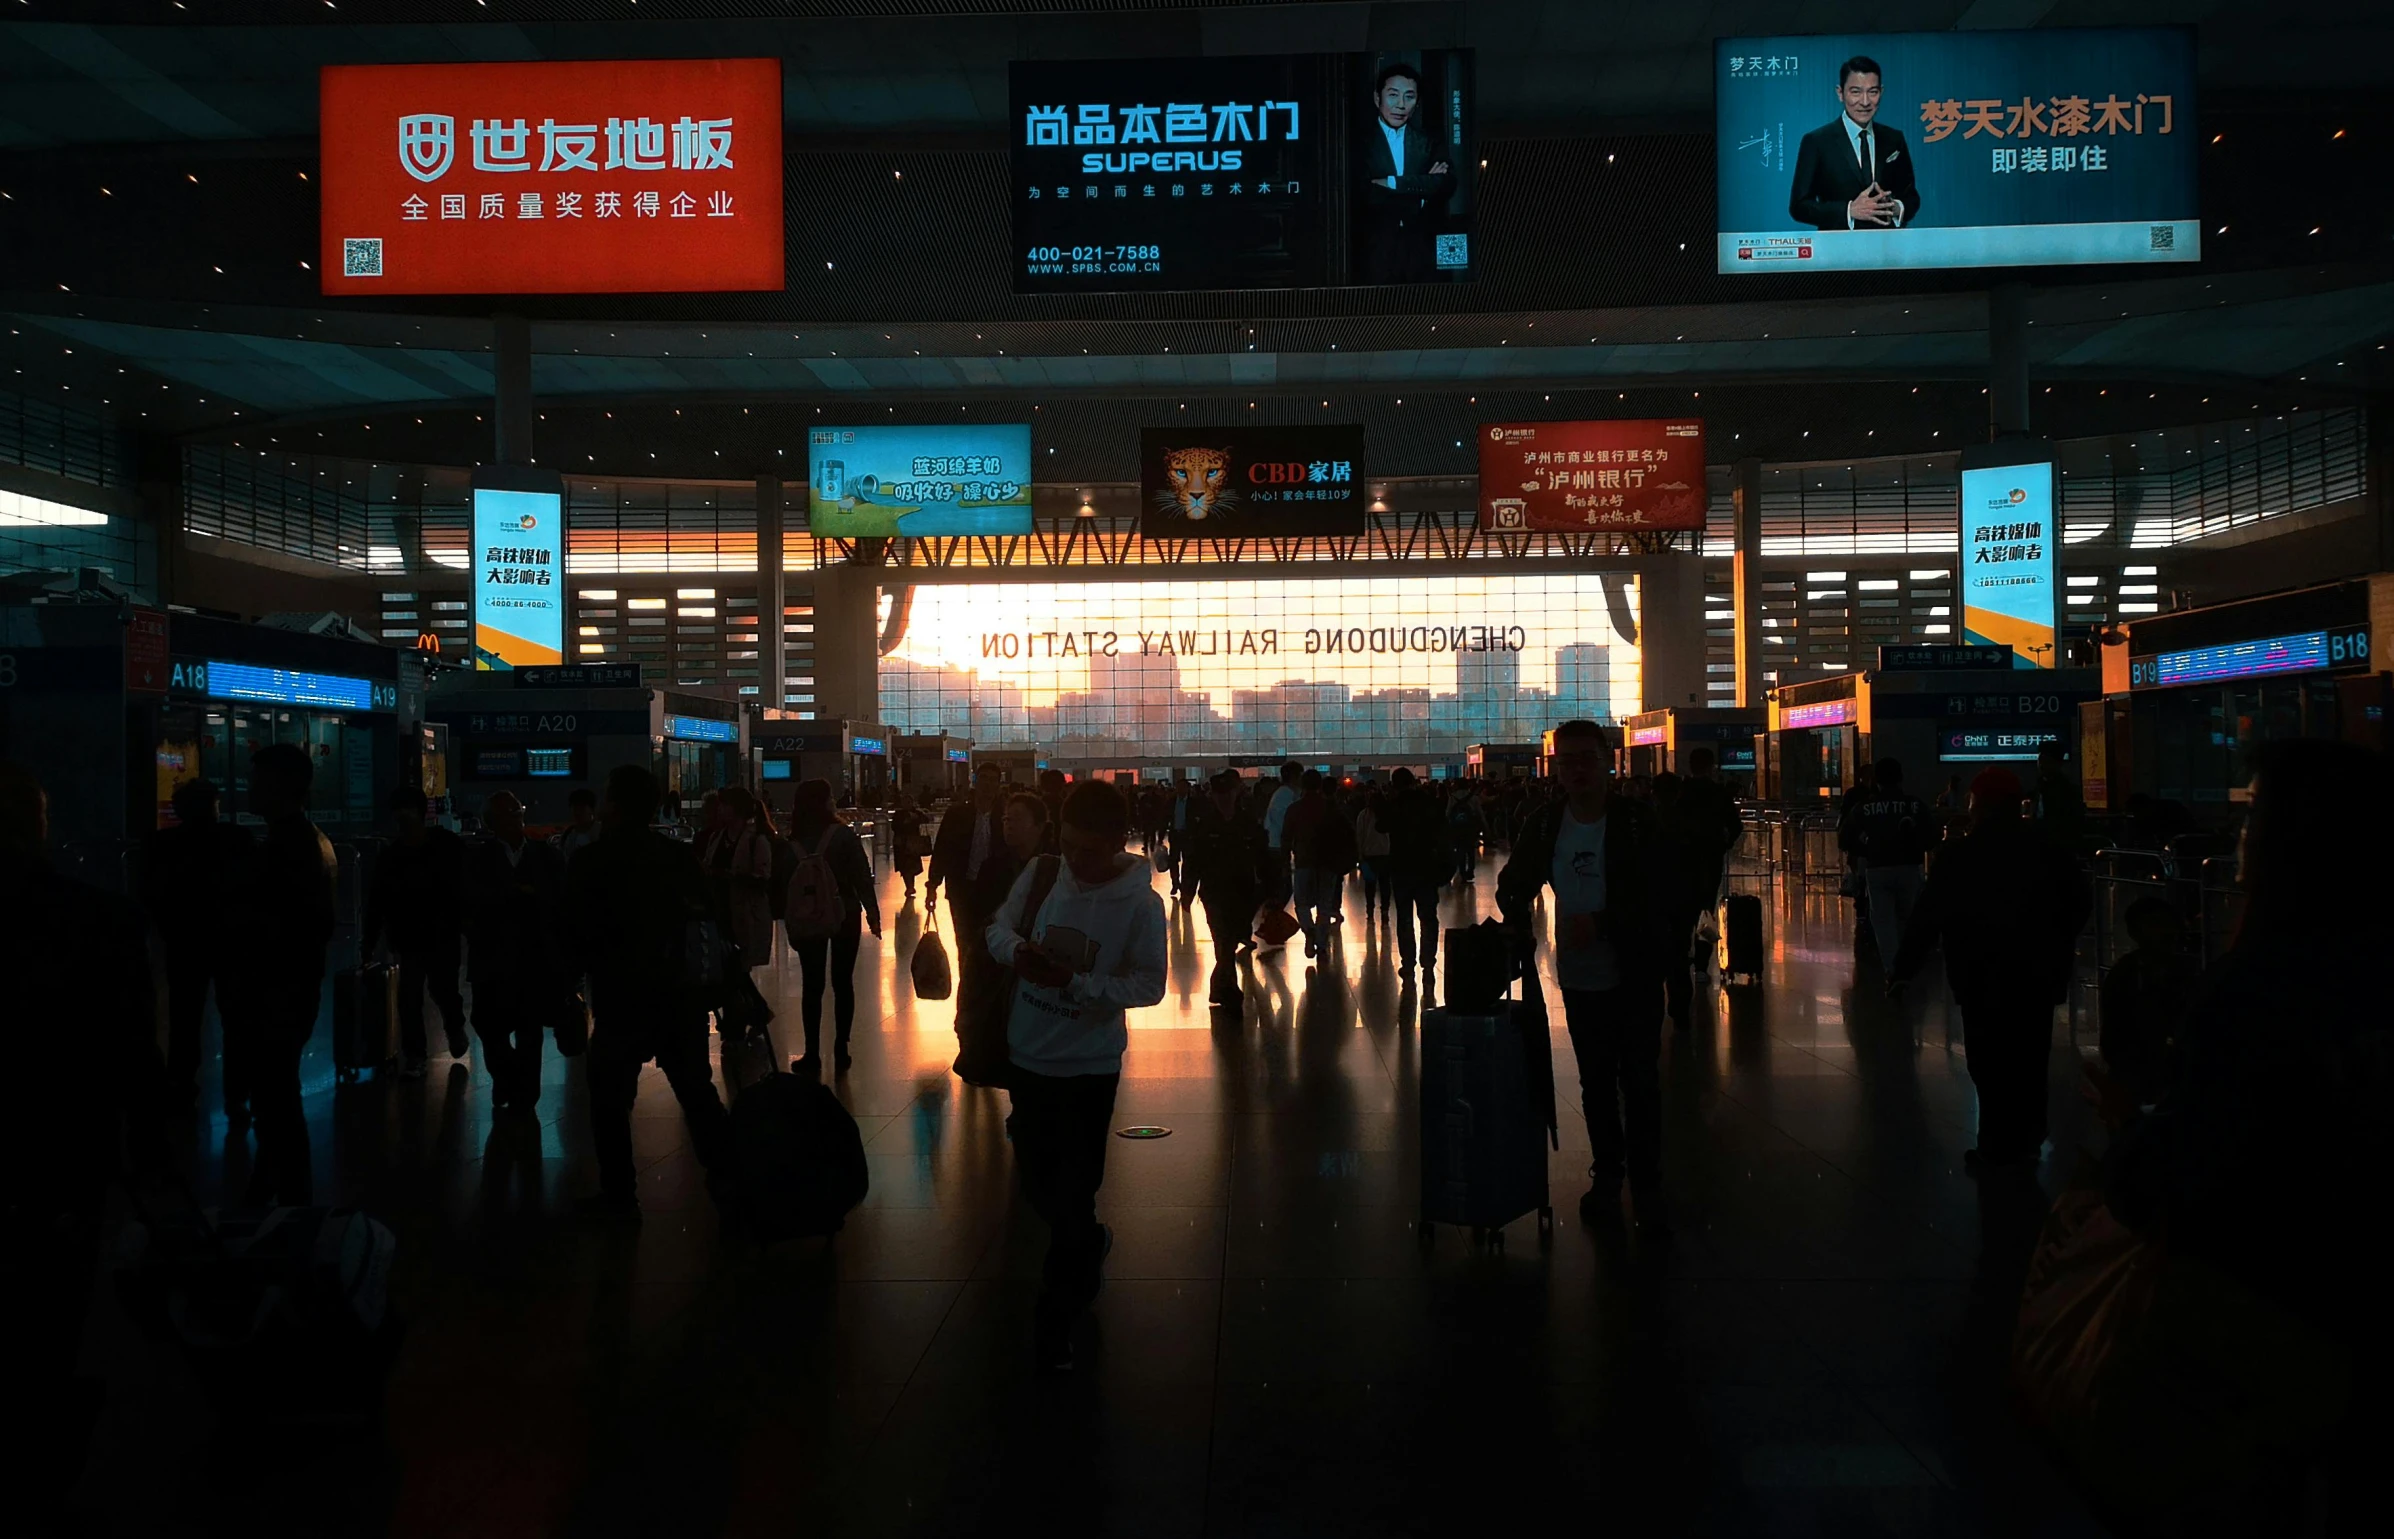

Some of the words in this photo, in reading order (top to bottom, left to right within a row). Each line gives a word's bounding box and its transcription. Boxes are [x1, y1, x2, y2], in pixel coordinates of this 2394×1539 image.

[1730, 55, 1798, 71] 梦天木门
[1026, 100, 1300, 146] 尚品本色木门
[1920, 93, 2173, 143] 梦天水漆木门
[468, 115, 735, 173] 世友地板
[1082, 150, 1242, 173] SUPERUS
[1991, 144, 2108, 174] 即装即住
[1028, 181, 1300, 199] 为空间而生的艺术木门
[400, 190, 735, 222] 全国质量奖获得企业
[1027, 245, 1160, 261] 400-021-7588
[1028, 262, 1160, 274] WWW.SPBS.COM.CN
[912, 456, 1001, 476] 蓝河绵羊奶
[1524, 449, 1669, 465] 泸州市商业银行更名为
[1975, 522, 2042, 543] 高铁媒体
[486, 547, 551, 566] 高铁媒体
[1975, 543, 2043, 564] 大影响者
[486, 568, 551, 585] 大影响者
[2331, 632, 2368, 661] B18
[171, 662, 205, 691] A18
[2133, 661, 2157, 685] B19
[373, 685, 397, 708] A19
[2018, 695, 2060, 714] B20
[536, 715, 577, 732] A20
[774, 738, 805, 751] A22
[1863, 800, 1890, 816] STAY
